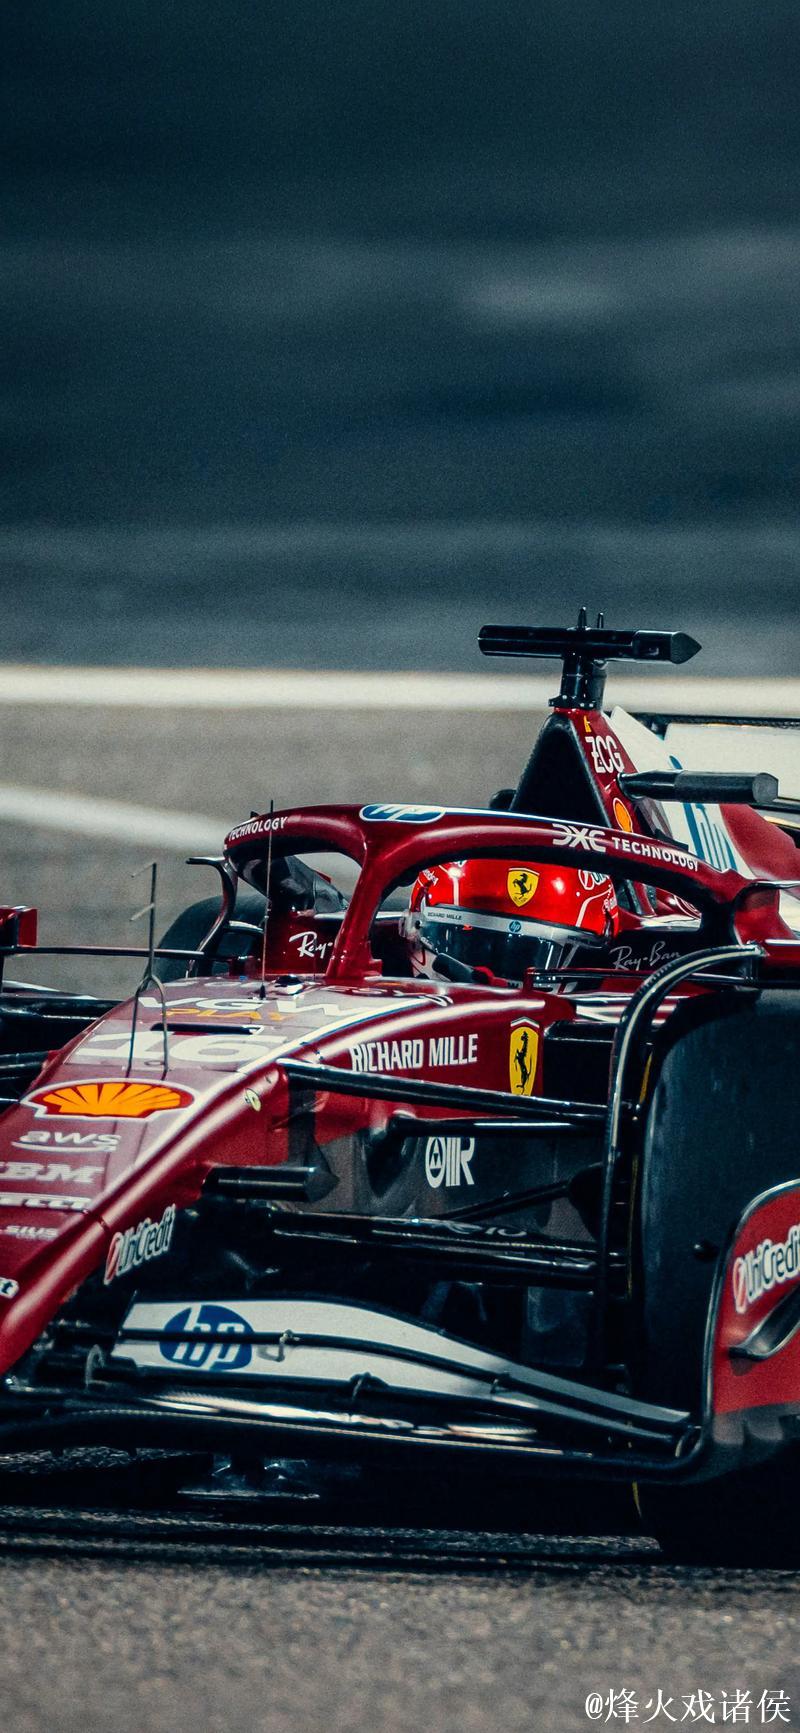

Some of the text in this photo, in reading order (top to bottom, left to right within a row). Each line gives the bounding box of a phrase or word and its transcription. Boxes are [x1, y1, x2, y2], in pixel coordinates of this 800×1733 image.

[585, 735, 625, 774] ZCG
[228, 816, 288, 842] TECHNOLOGY
[611, 836, 700, 872] TECHNOLOGY
[509, 920, 522, 933] hp
[608, 940, 681, 971] Ray-Ban
[75, 1030, 289, 1063] 16
[350, 1033, 479, 1073] RICHARD MILLE
[15, 1130, 122, 1149] aws
[0, 1162, 104, 1183] BM
[744, 1222, 800, 1304] UniCredi
[165, 1305, 252, 1371] hp
